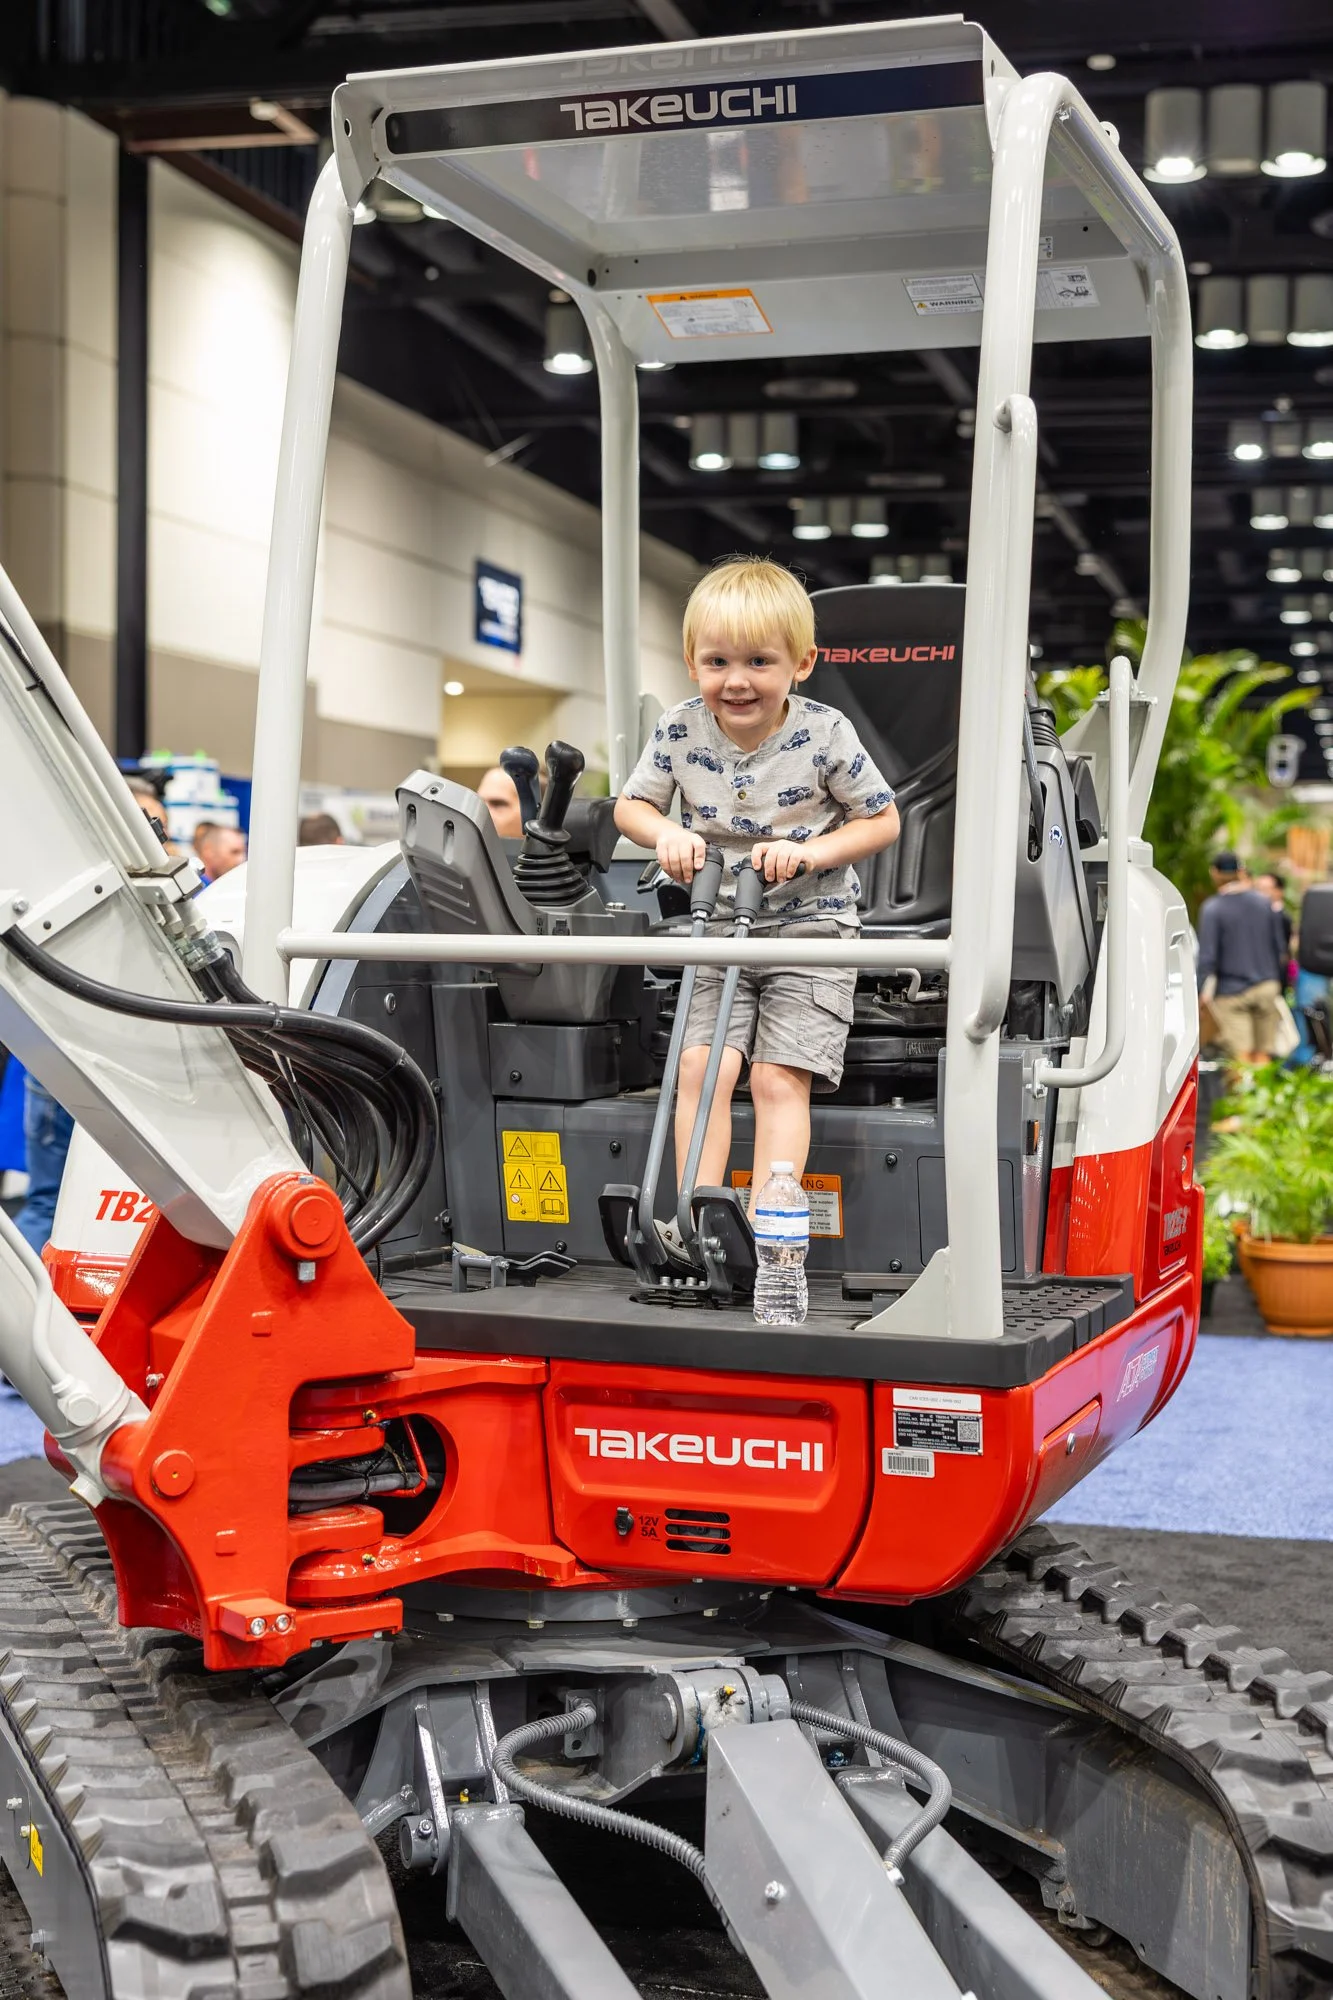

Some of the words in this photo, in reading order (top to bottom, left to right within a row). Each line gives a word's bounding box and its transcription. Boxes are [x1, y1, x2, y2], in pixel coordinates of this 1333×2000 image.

[560, 85, 797, 131] TAKEUCHI
[574, 1427, 824, 1472] TAKEUCHI
[638, 1515, 659, 1527] 12V
[641, 1526, 658, 1538] 5A
